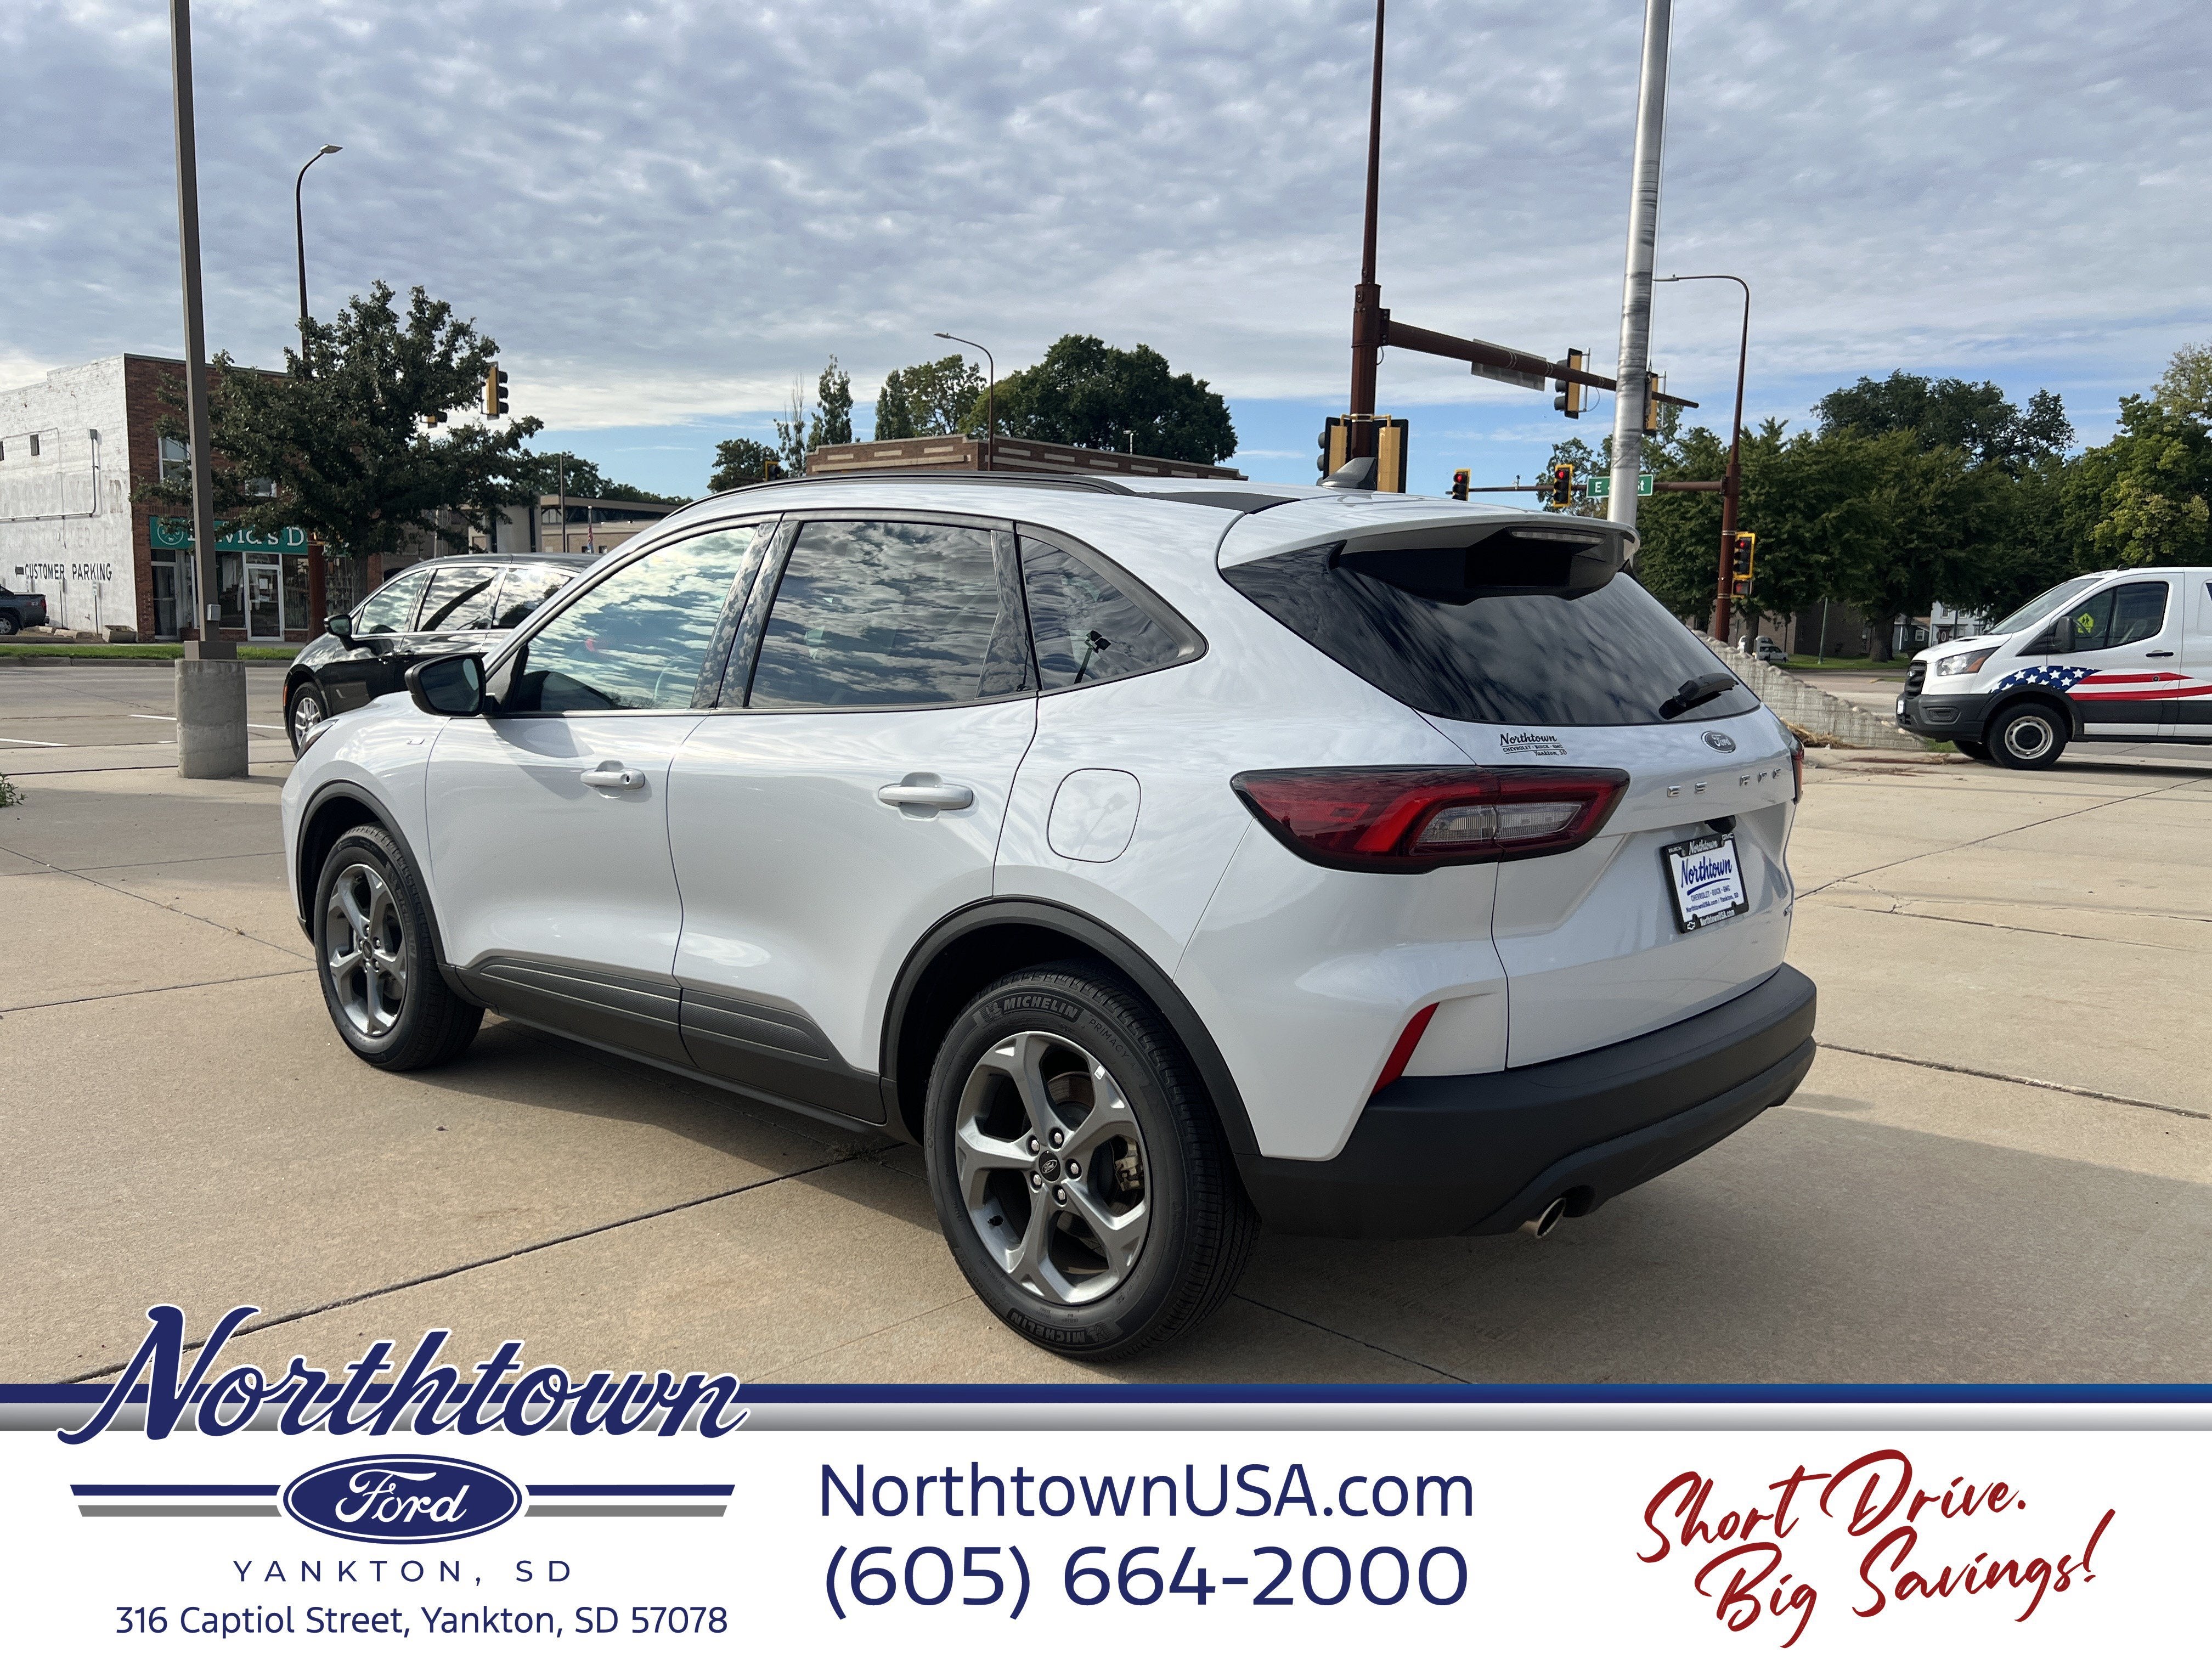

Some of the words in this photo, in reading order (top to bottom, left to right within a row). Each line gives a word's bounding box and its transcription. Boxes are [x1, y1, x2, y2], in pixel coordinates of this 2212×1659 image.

[1595, 481, 1602, 493] E
[25, 563, 65, 579] CUSTOMER
[72, 563, 112, 580] PARKING
[1500, 732, 1557, 746] Northtown
[1689, 839, 1718, 855] Northtown
[1681, 856, 1732, 888] Northtown
[1003, 995, 1079, 1019] MICHELIN
[1088, 1018, 1130, 1058] PRIMACY
[1012, 1311, 1086, 1344] MICHELIN
